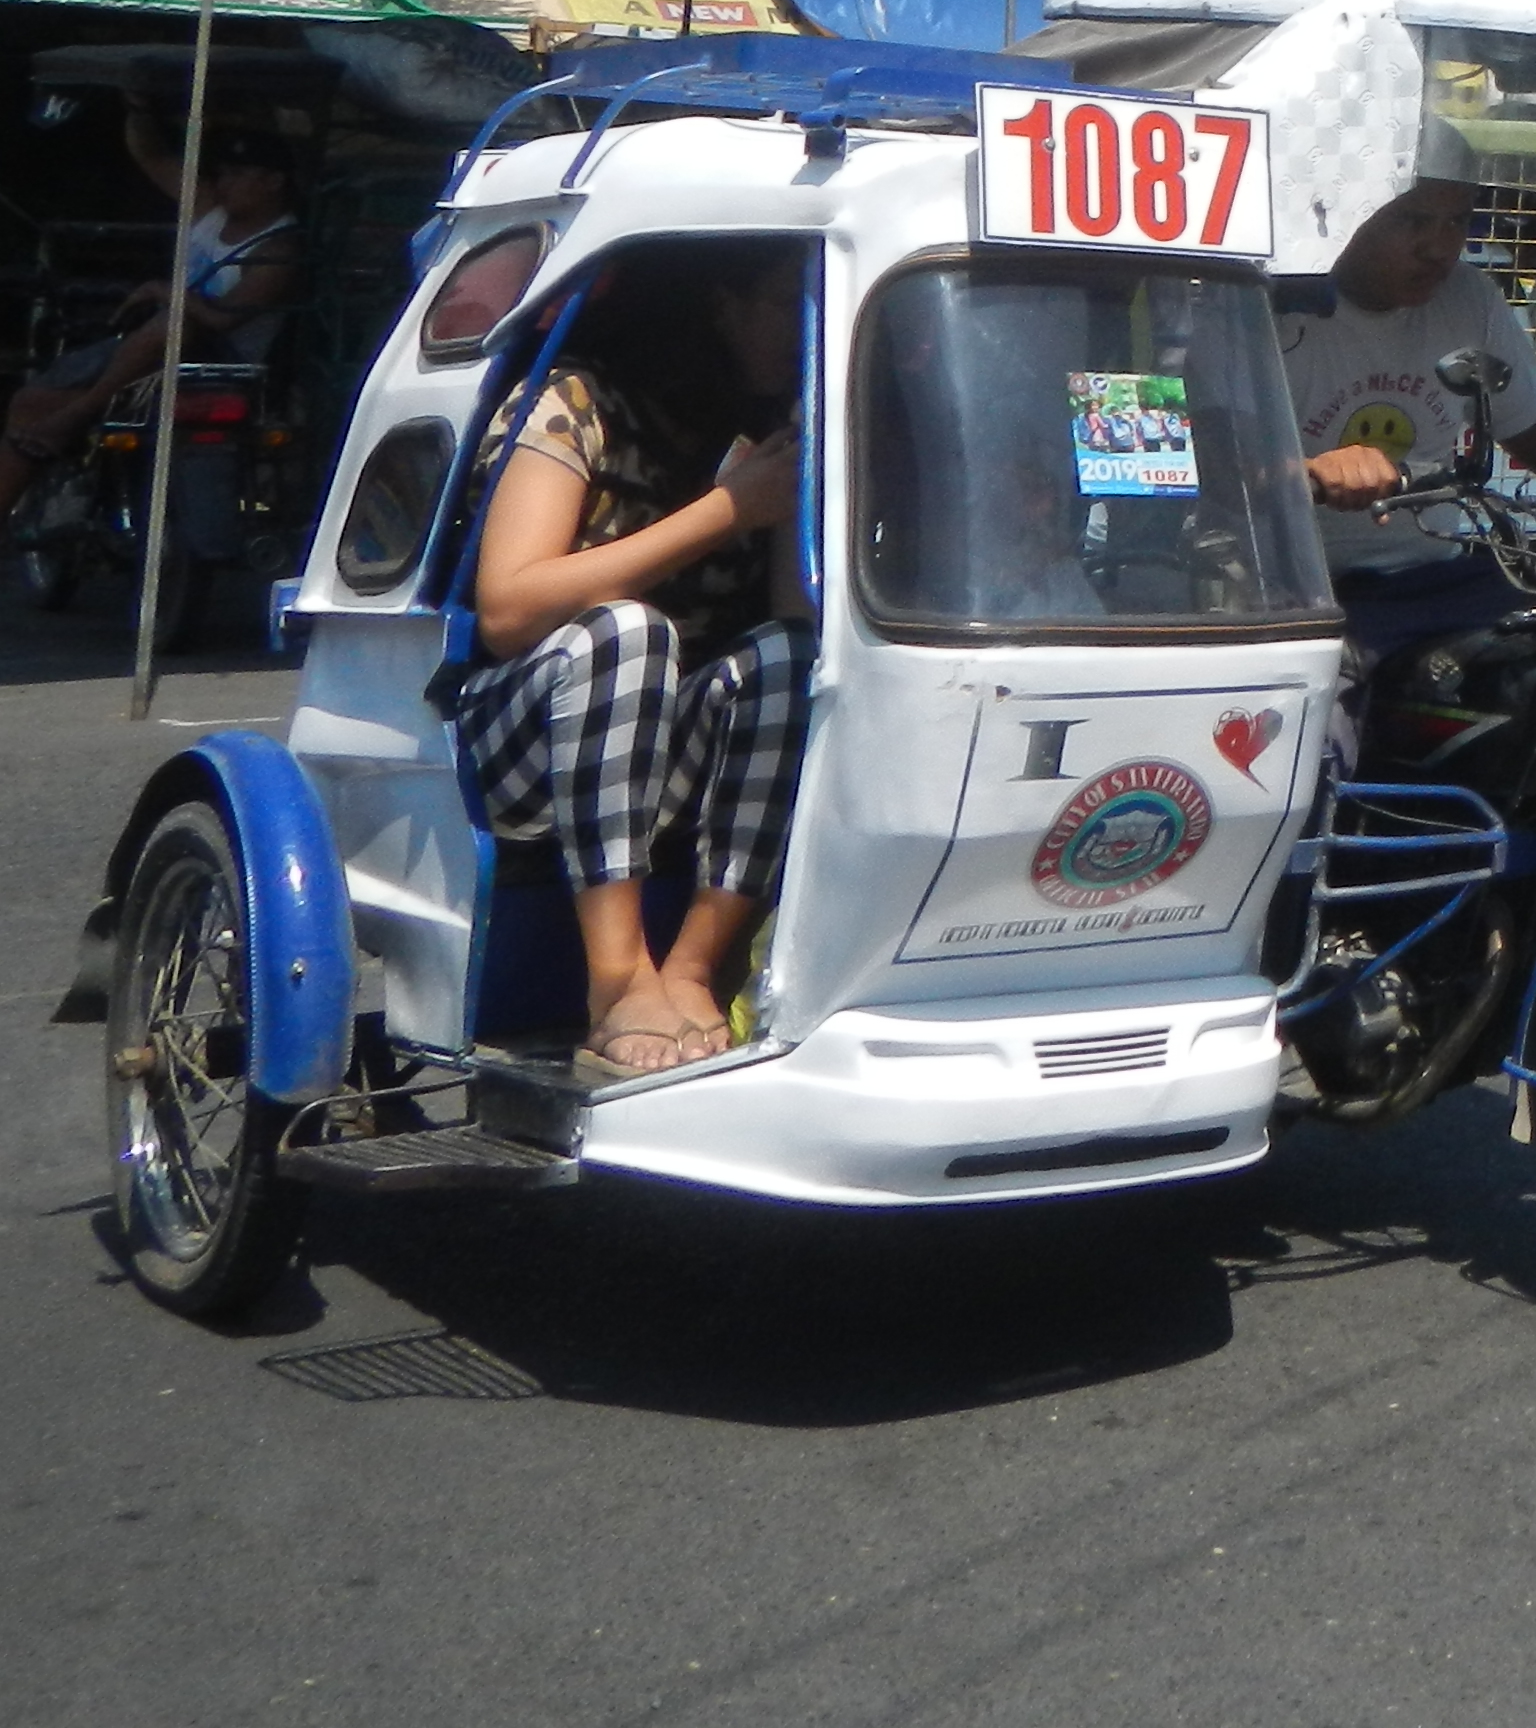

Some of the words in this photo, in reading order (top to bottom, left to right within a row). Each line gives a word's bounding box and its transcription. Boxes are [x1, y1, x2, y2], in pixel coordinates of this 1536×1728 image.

[625, 0, 650, 16] A
[667, 3, 744, 21] NEW
[1004, 99, 1251, 245] 1087
[1303, 388, 1349, 438] Have
[1352, 380, 1363, 397] a
[1079, 459, 1139, 482] 2019
[1142, 470, 1190, 483] 1087
[1006, 718, 1090, 781] I
